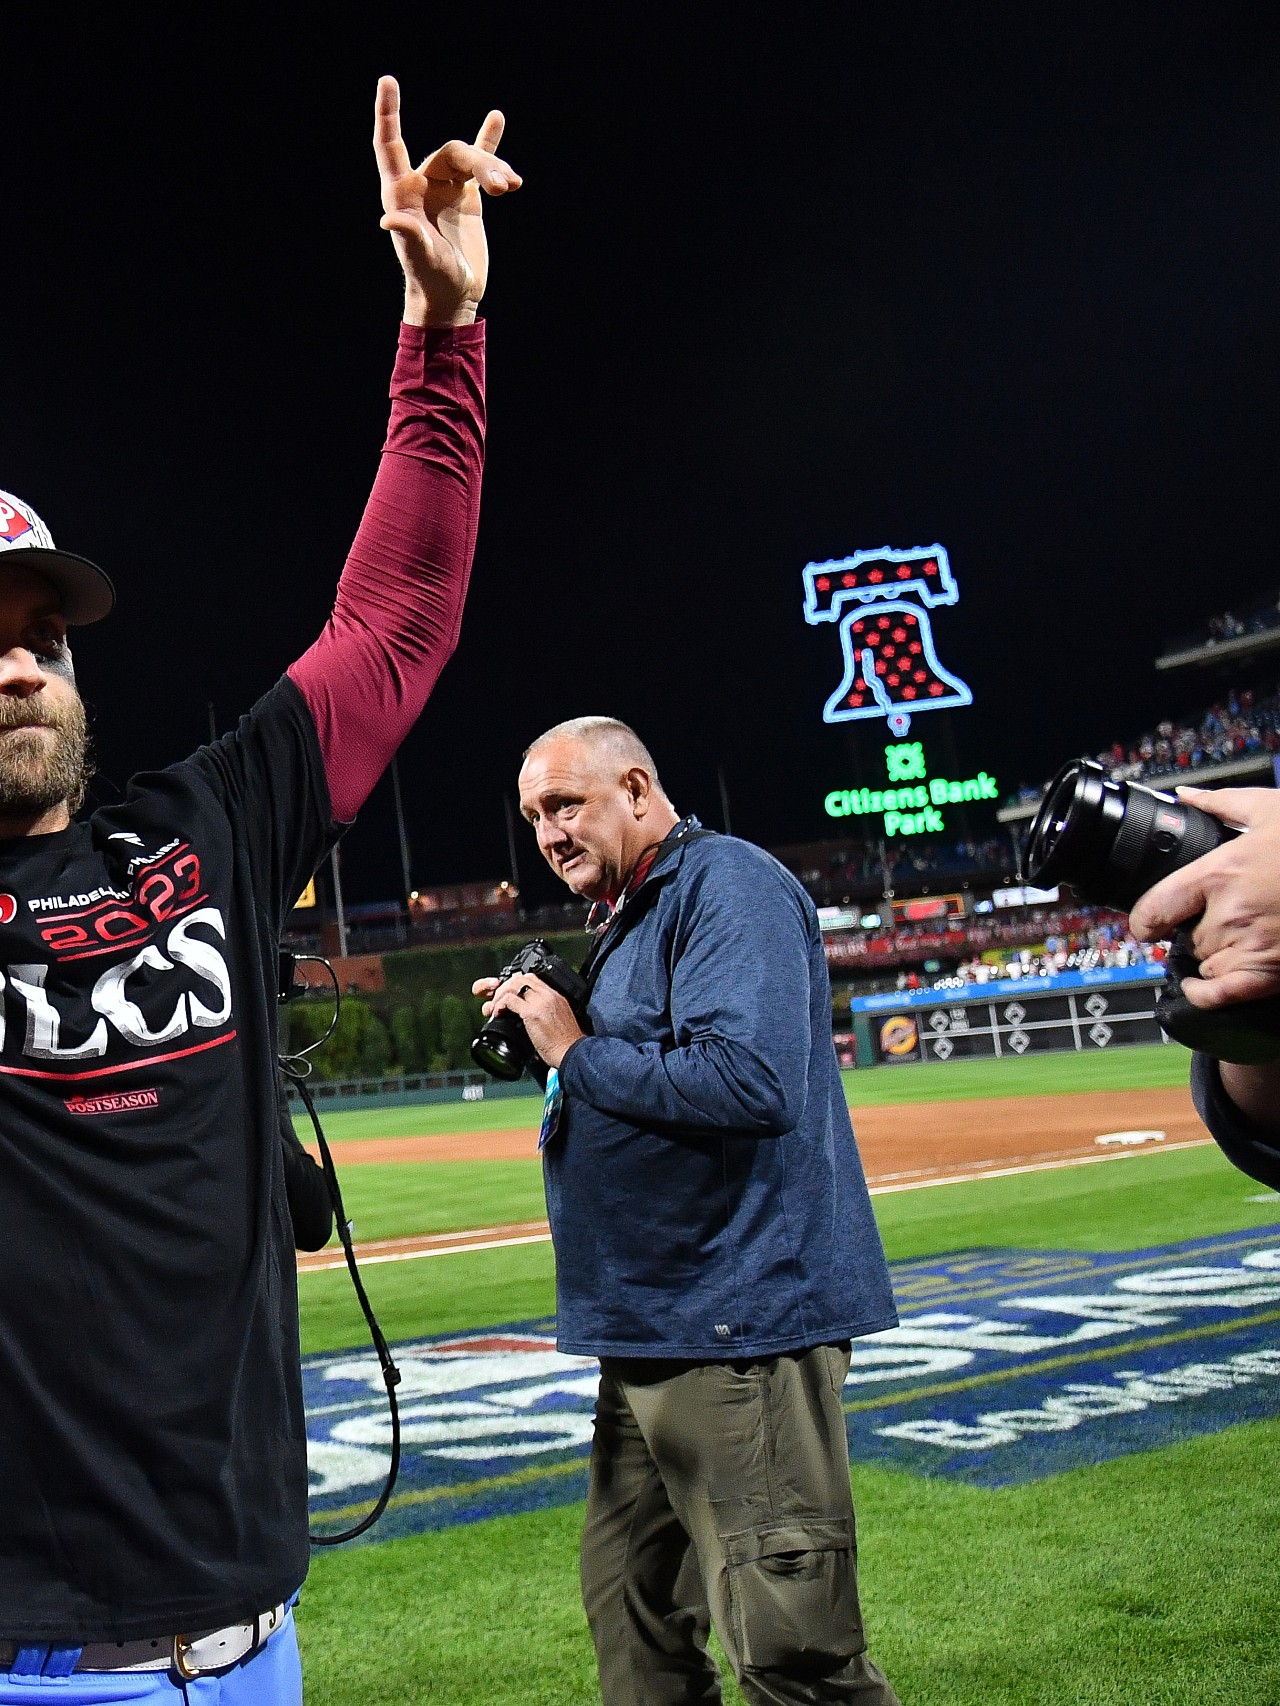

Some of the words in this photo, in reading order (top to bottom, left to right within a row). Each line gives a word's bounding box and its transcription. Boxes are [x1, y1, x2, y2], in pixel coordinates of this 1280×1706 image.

[824, 787, 929, 817] Citizens
[929, 771, 999, 805] Bank
[884, 805, 945, 836] Park
[41, 854, 200, 950] 2023
[66, 1091, 158, 1113] POSTSEASON
